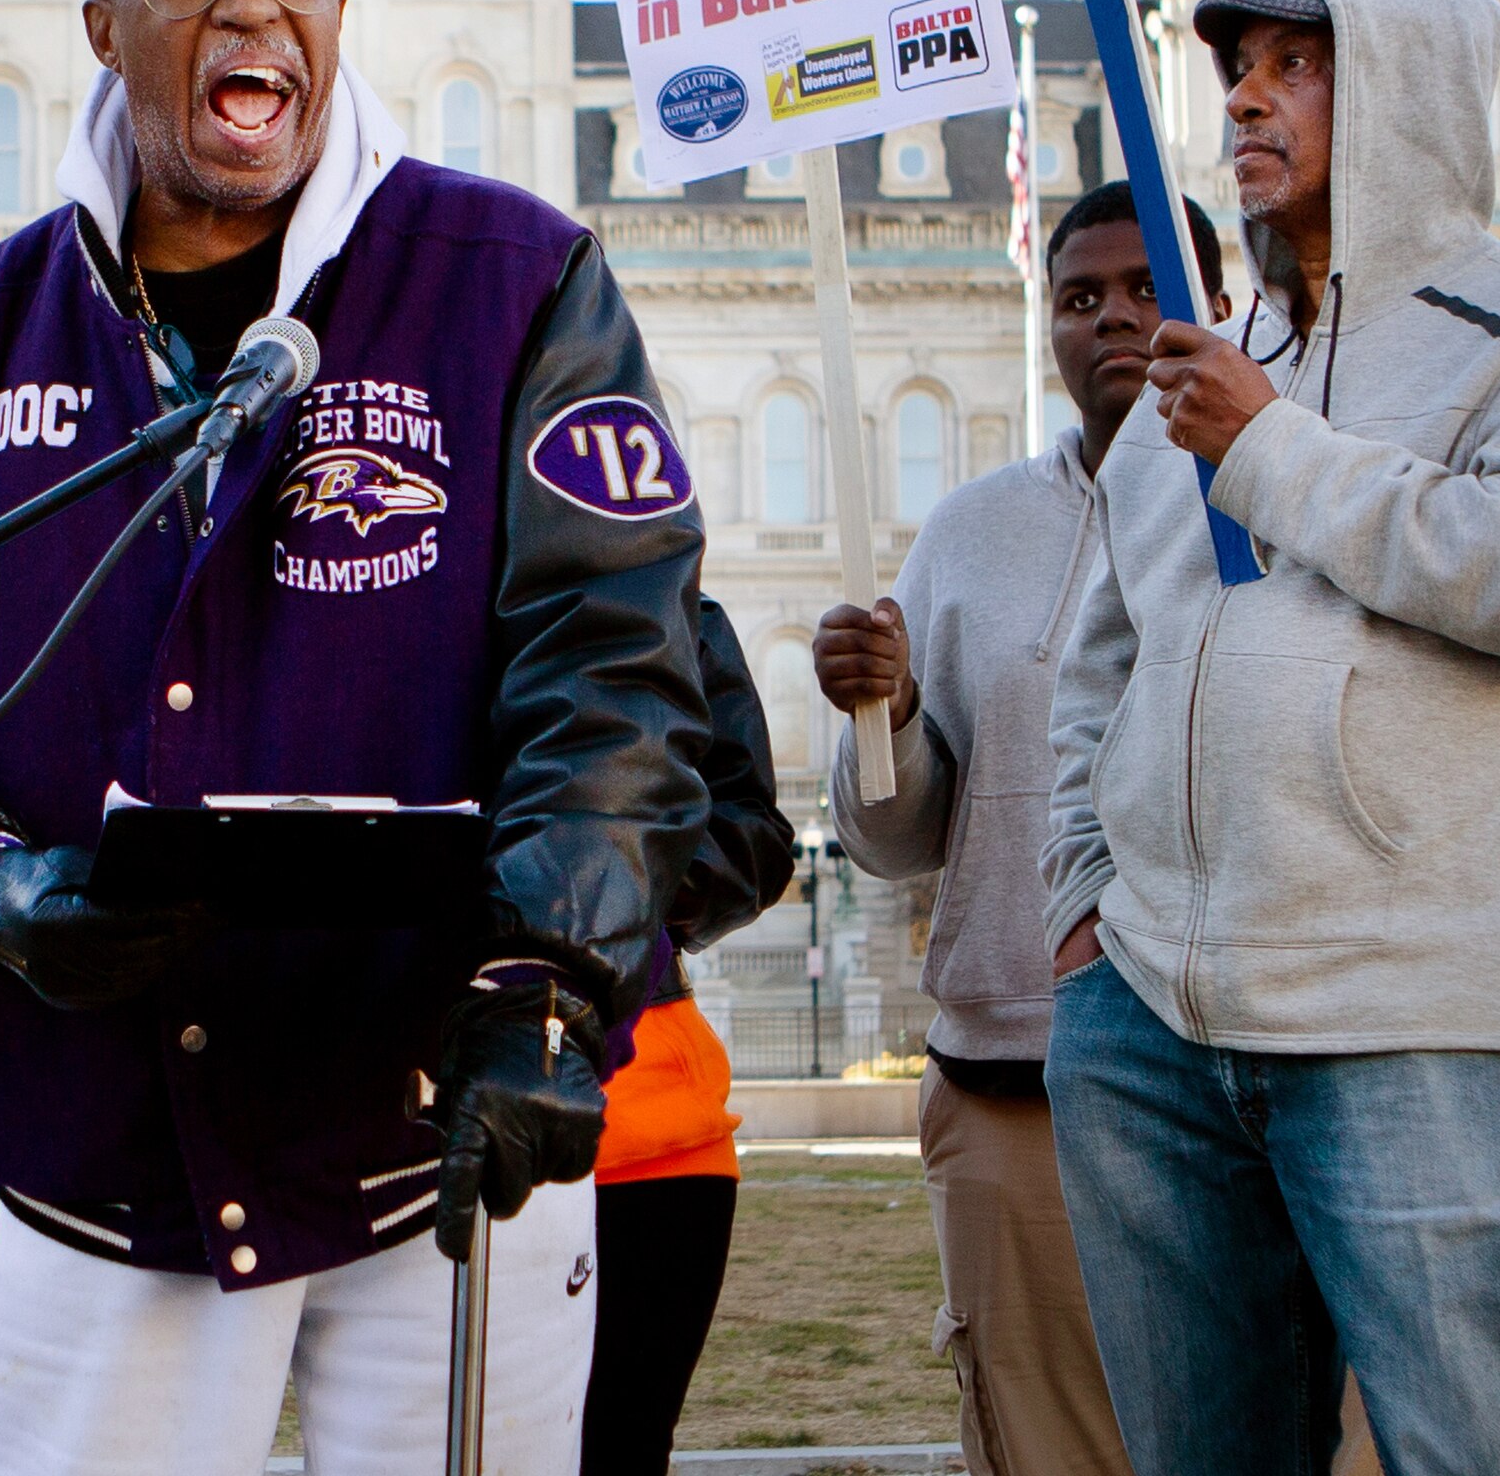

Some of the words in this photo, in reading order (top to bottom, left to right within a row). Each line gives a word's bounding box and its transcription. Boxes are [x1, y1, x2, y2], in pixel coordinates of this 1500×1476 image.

[895, 6, 973, 40] BALTO
[804, 48, 868, 75] Unemployed
[898, 26, 979, 76] PPA
[668, 73, 728, 101] WELCOME
[802, 72, 844, 92] Workers
[844, 65, 874, 83] Union
[663, 101, 700, 119] MATTHEW
[303, 380, 430, 413] -TIME
[292, 408, 354, 454] PER
[364, 408, 451, 469] BOWL
[568, 425, 676, 501] '12
[274, 526, 439, 593] CHAMPIONS
